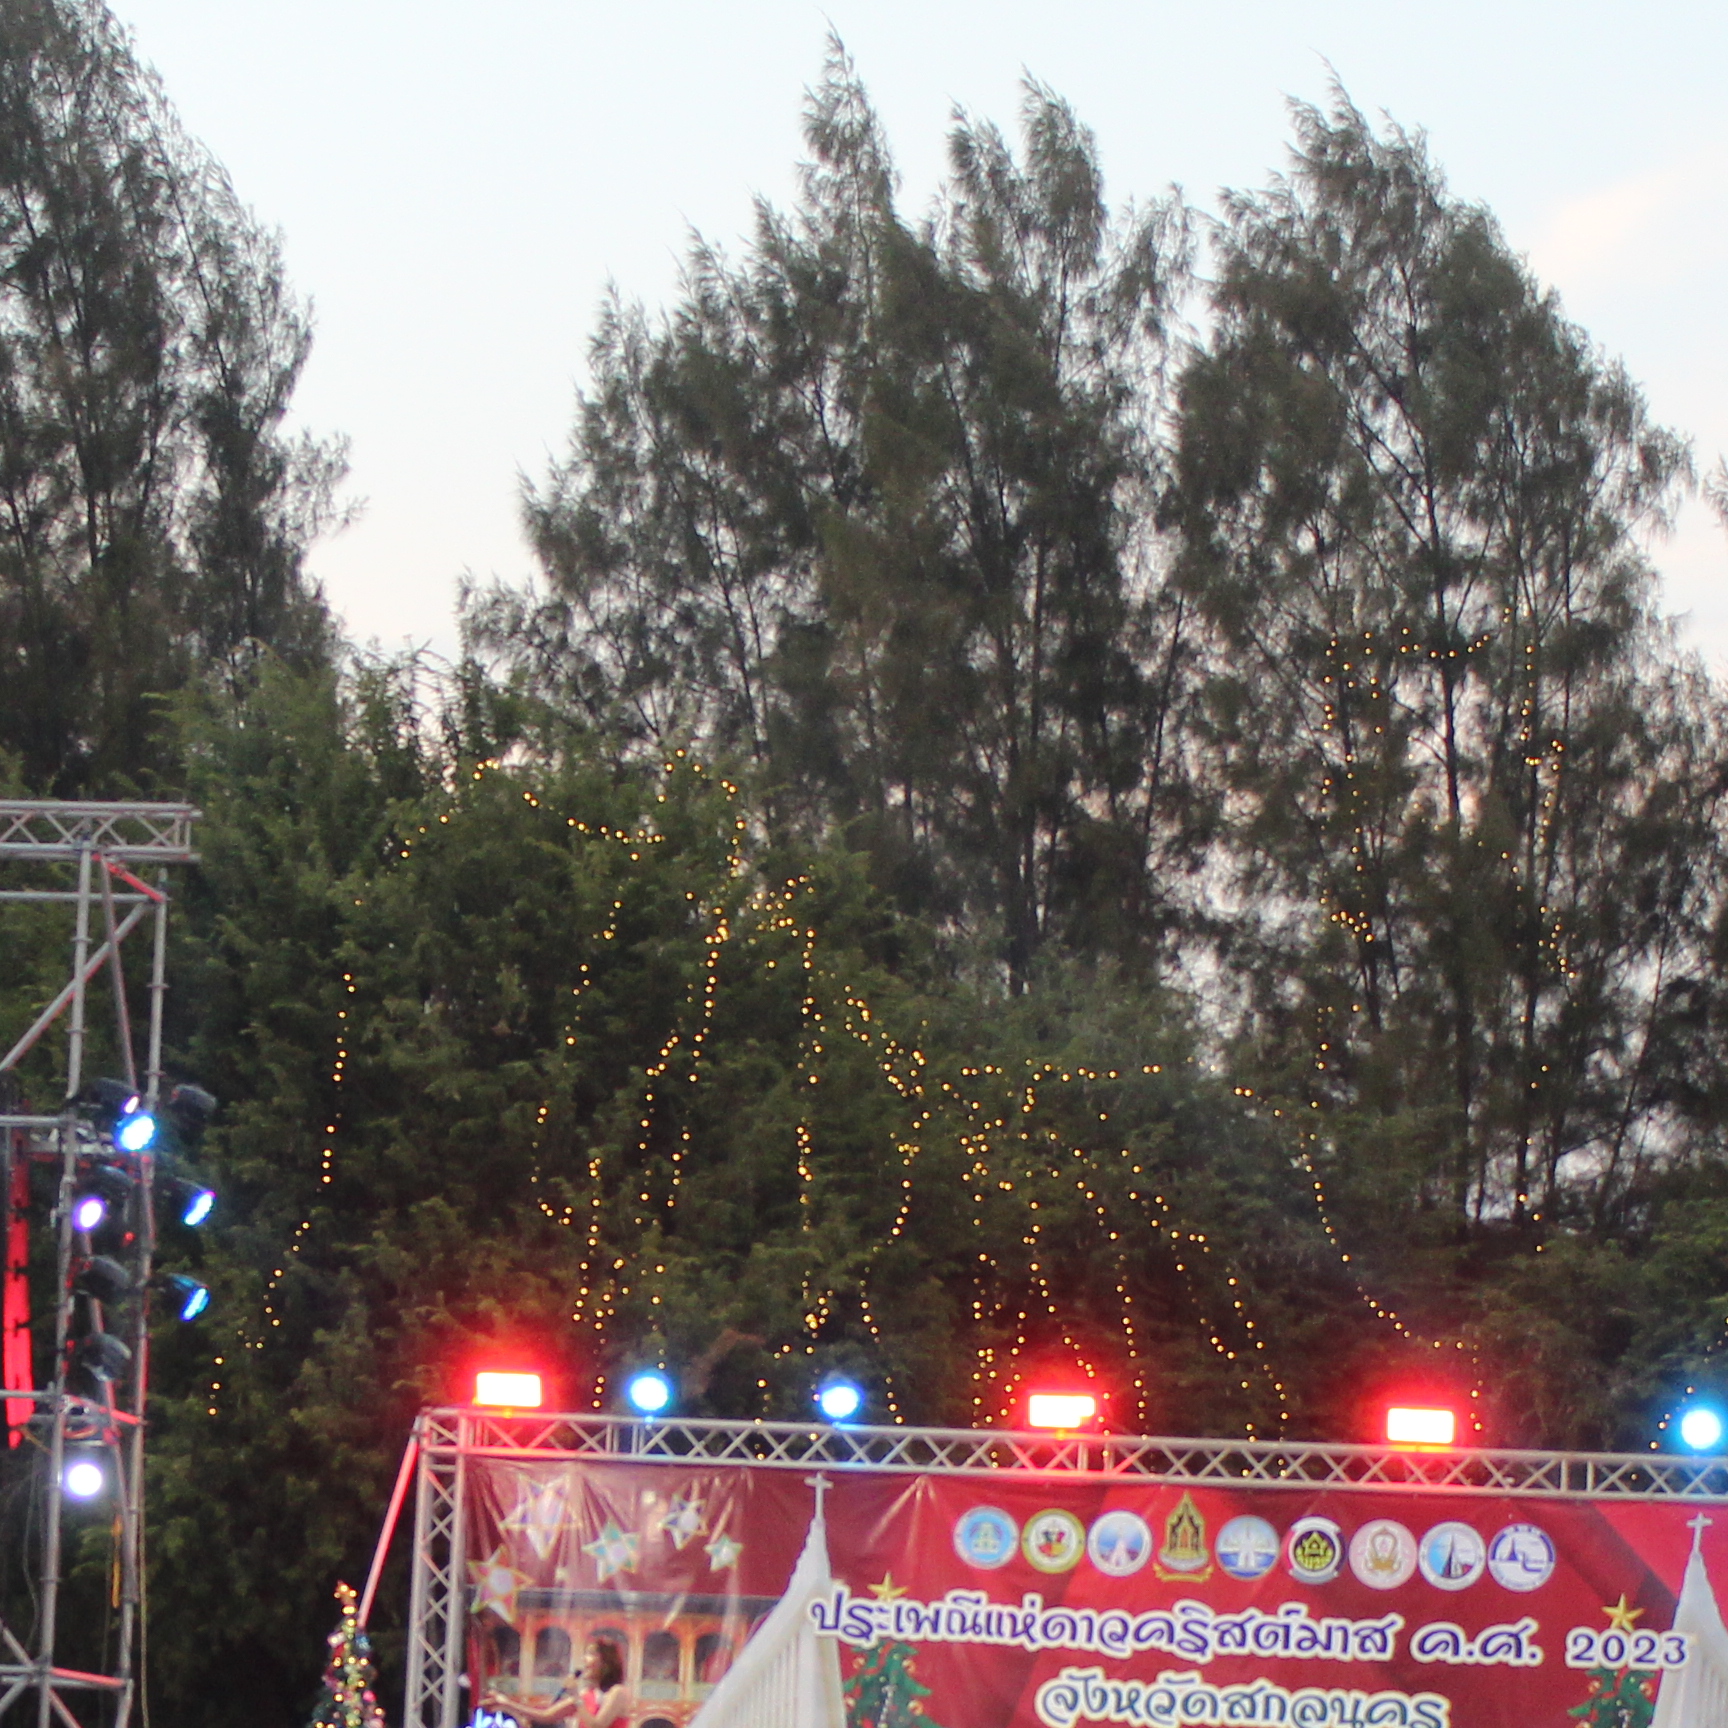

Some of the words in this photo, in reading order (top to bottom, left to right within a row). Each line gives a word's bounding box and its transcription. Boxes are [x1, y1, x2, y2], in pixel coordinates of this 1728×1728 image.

[809, 1588, 1399, 1658] ประเพณีแห่ดาวคริสต์มาส
[1415, 1620, 1539, 1661] ค.ศ.
[1571, 1629, 1687, 1668] 2023
